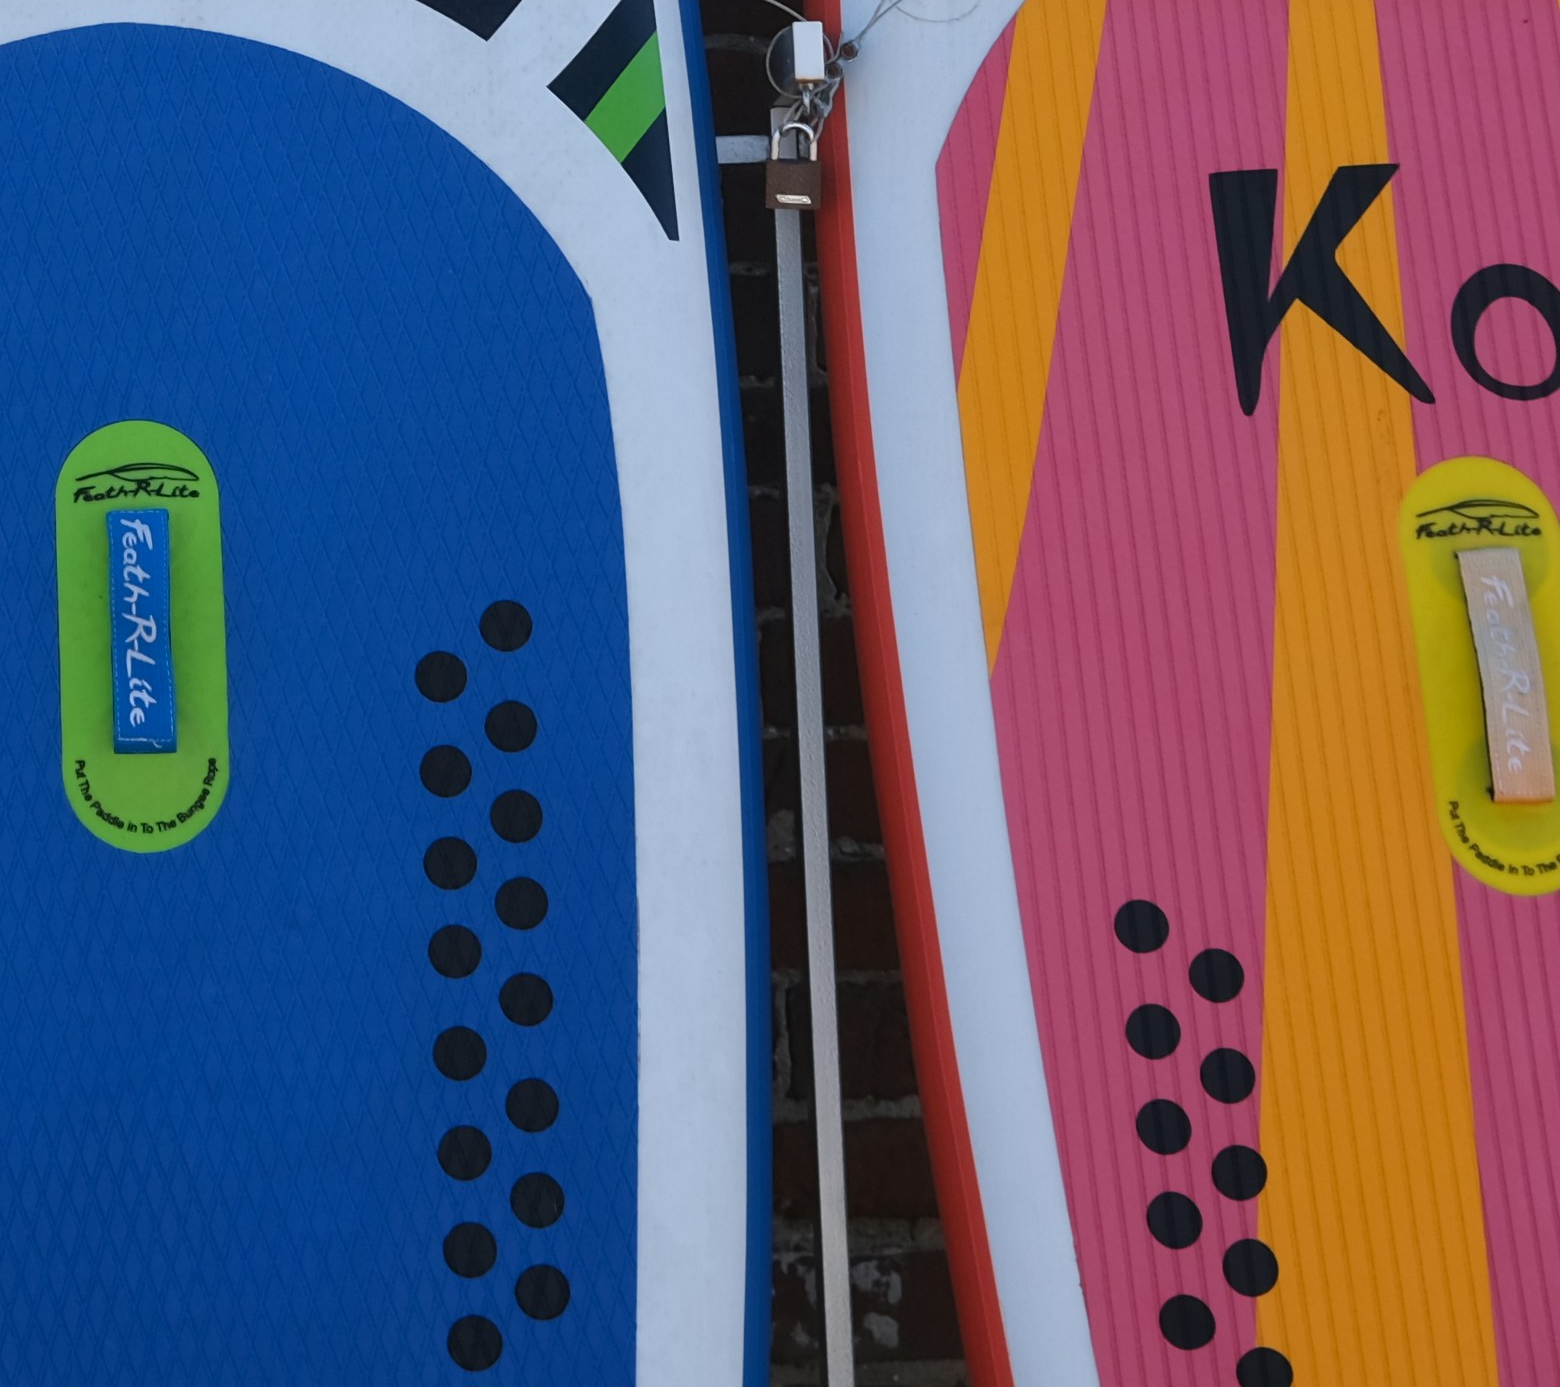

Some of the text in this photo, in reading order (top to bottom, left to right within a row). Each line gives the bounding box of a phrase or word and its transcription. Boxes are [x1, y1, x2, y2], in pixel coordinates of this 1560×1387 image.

[120, 518, 157, 727] Feath-R-Lite
[75, 760, 86, 779] Put
[203, 757, 218, 786] Rope
[78, 779, 92, 802] The
[90, 801, 124, 829] Paddle
[176, 787, 210, 823] Bungee
[141, 823, 154, 834] To
[156, 819, 177, 832] The
[1449, 801, 1460, 820] Put
[1455, 822, 1469, 844] The
[1469, 843, 1505, 871] Paddle
[1520, 865, 1535, 876] To
[1536, 861, 1557, 874] The
